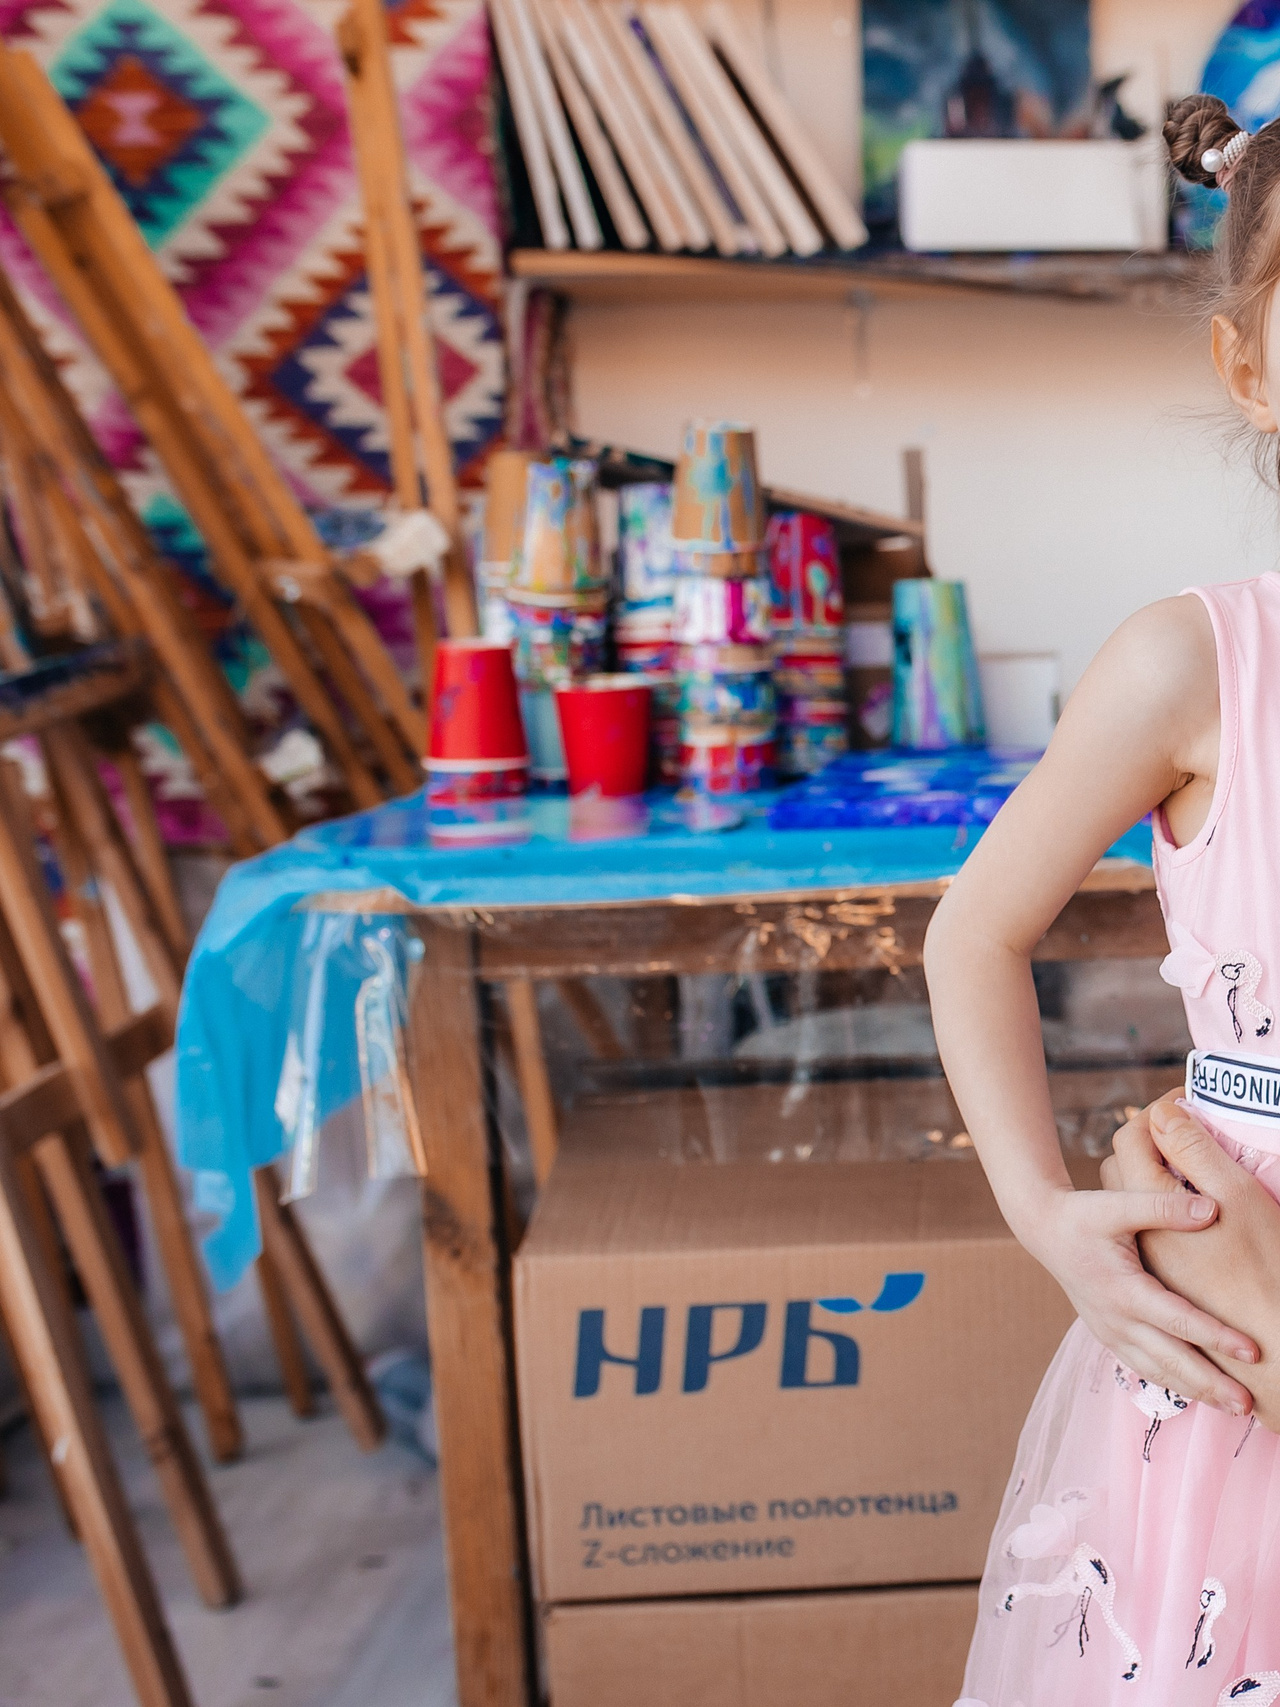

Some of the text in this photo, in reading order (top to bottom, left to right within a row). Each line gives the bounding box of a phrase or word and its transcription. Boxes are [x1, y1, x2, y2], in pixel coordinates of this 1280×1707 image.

[574, 1273, 926, 1398] НРБ
[579, 1489, 959, 1530] Листовые полотенца
[582, 1536, 796, 1569] Z-сложение
